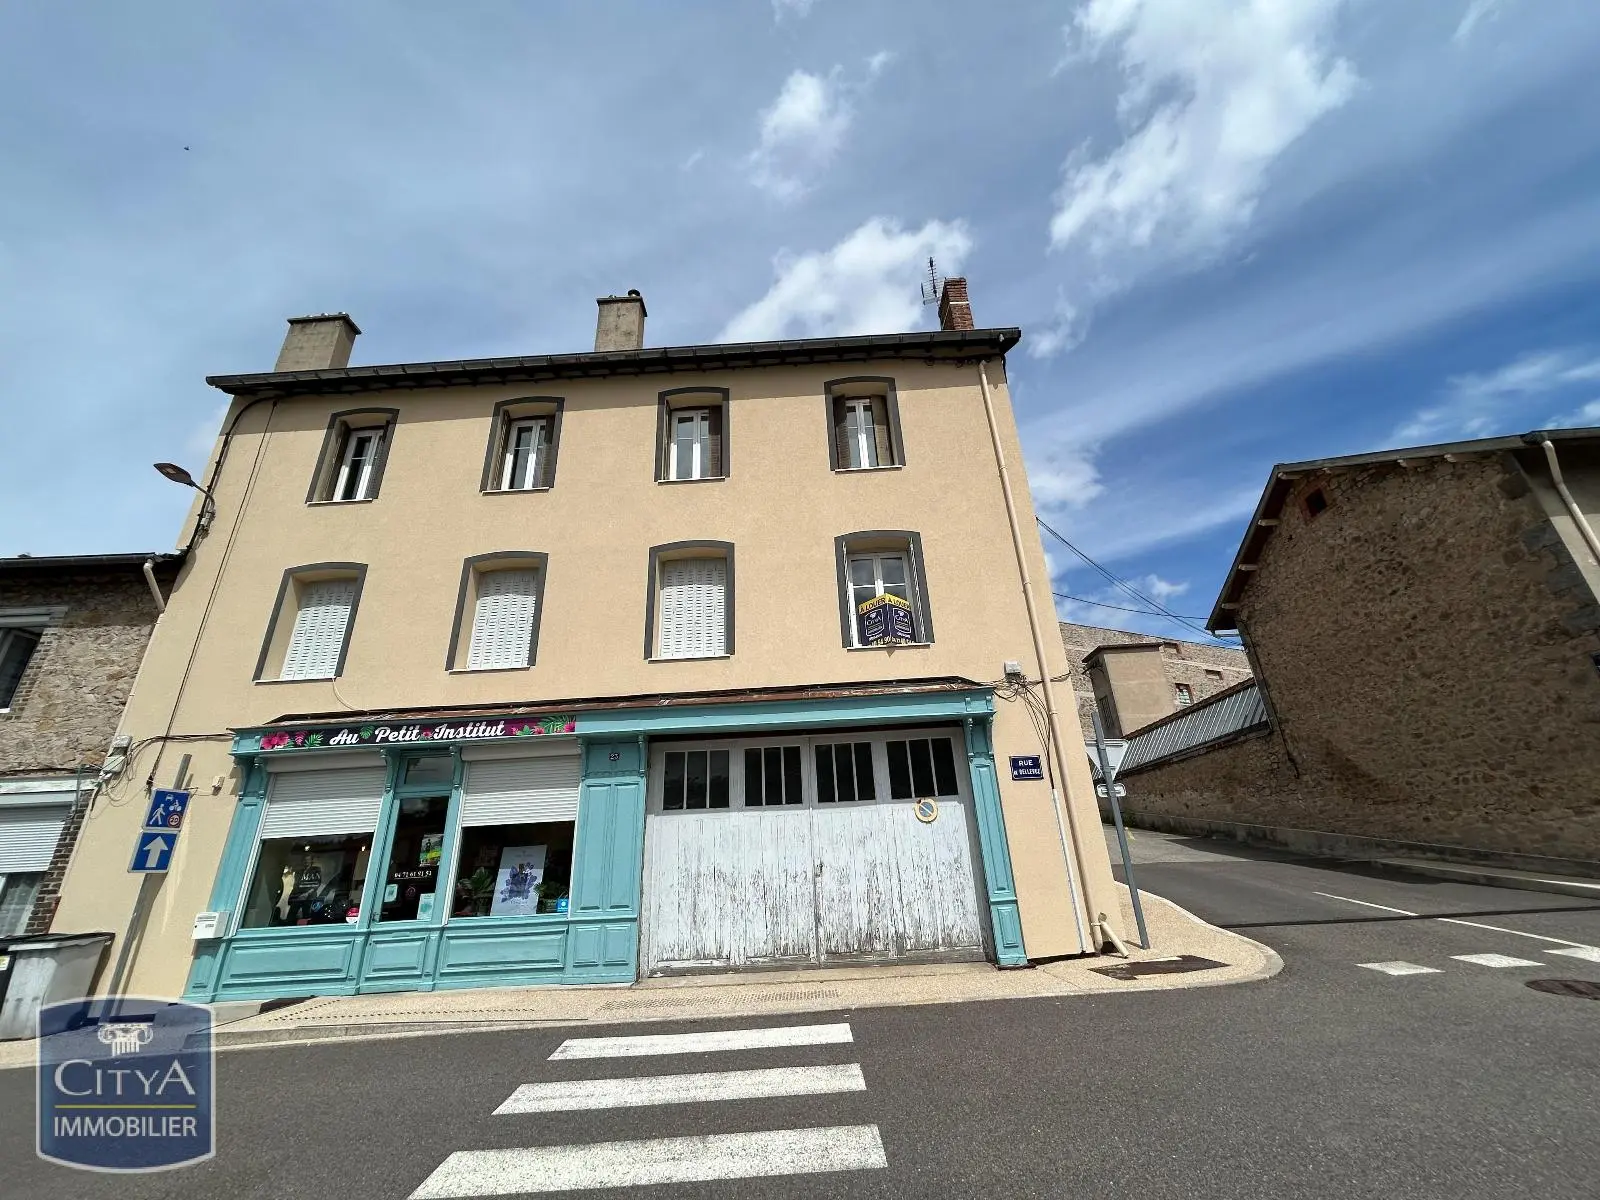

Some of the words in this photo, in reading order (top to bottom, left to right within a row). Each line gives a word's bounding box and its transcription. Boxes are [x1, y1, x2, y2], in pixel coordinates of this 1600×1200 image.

[329, 728, 360, 745] Au
[374, 725, 420, 743] Petit
[433, 720, 506, 739] Institut
[169, 815, 179, 824] 20
